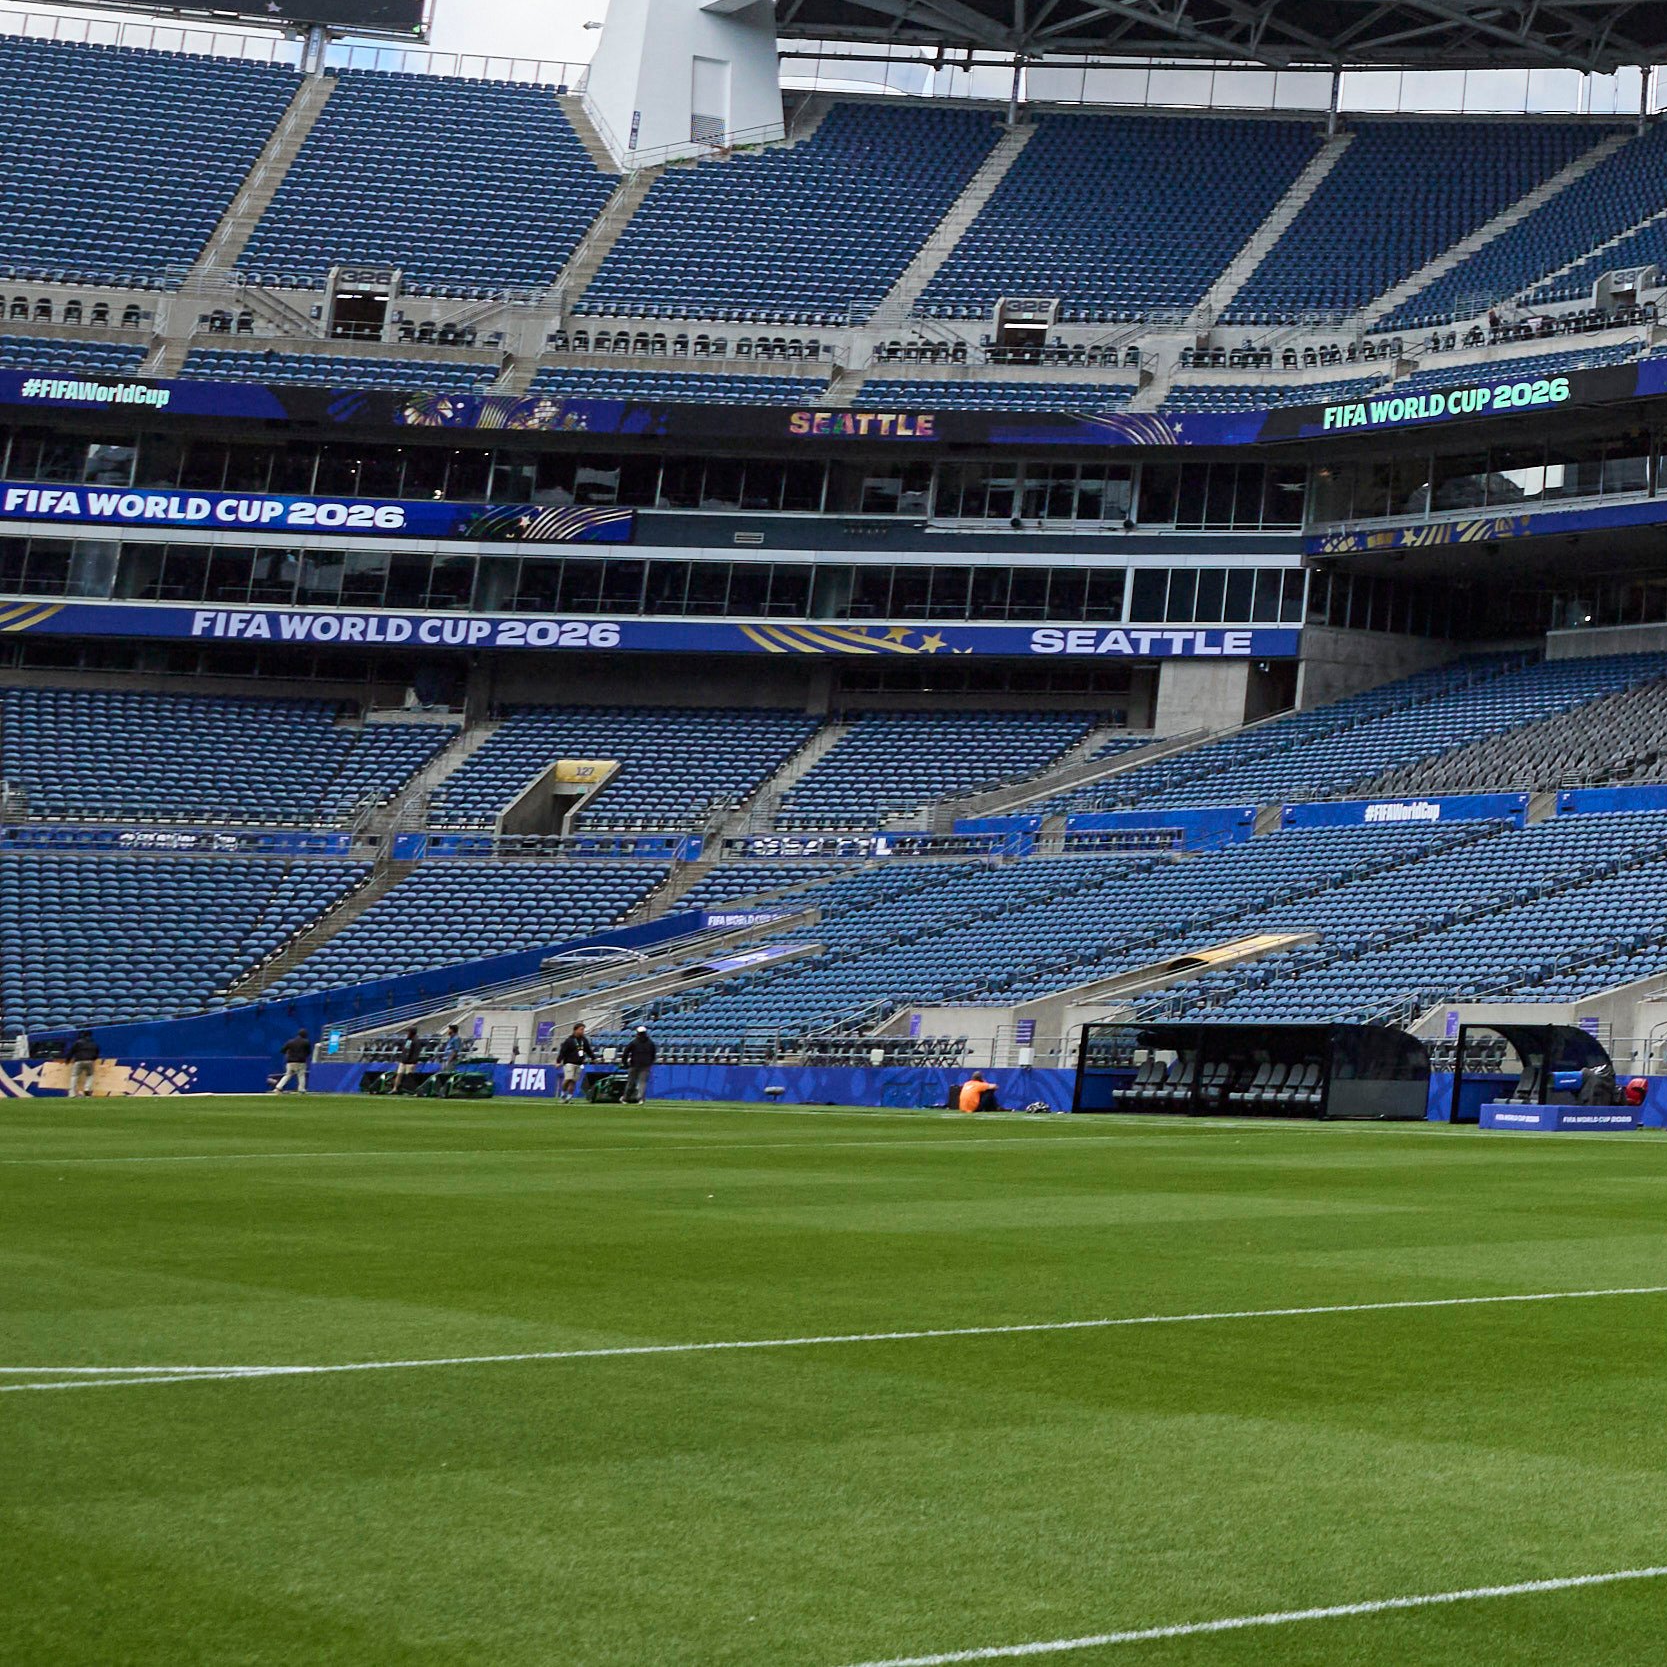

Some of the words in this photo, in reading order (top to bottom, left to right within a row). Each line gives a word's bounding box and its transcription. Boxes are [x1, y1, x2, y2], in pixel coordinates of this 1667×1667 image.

[21, 378, 170, 409] #FIFAWorldCup
[1323, 405, 1368, 430] FIFA
[1369, 393, 1445, 424] WORLD
[1447, 387, 1491, 414] CUP
[1492, 377, 1570, 409] 2026
[789, 411, 936, 436] SEATTLE
[4, 488, 81, 515] FIFA
[88, 492, 211, 521] WORLD
[216, 499, 284, 523] CUP
[287, 502, 405, 528] 2026
[192, 611, 271, 639] FIFA
[279, 614, 412, 643] WORLD
[419, 618, 492, 645] CUP
[495, 621, 621, 647] 2026
[1030, 628, 1252, 655] SEATTLE
[576, 767, 595, 776] 127
[1364, 801, 1440, 823] #FIFAWorldCup
[510, 1068, 546, 1091] FIFA
